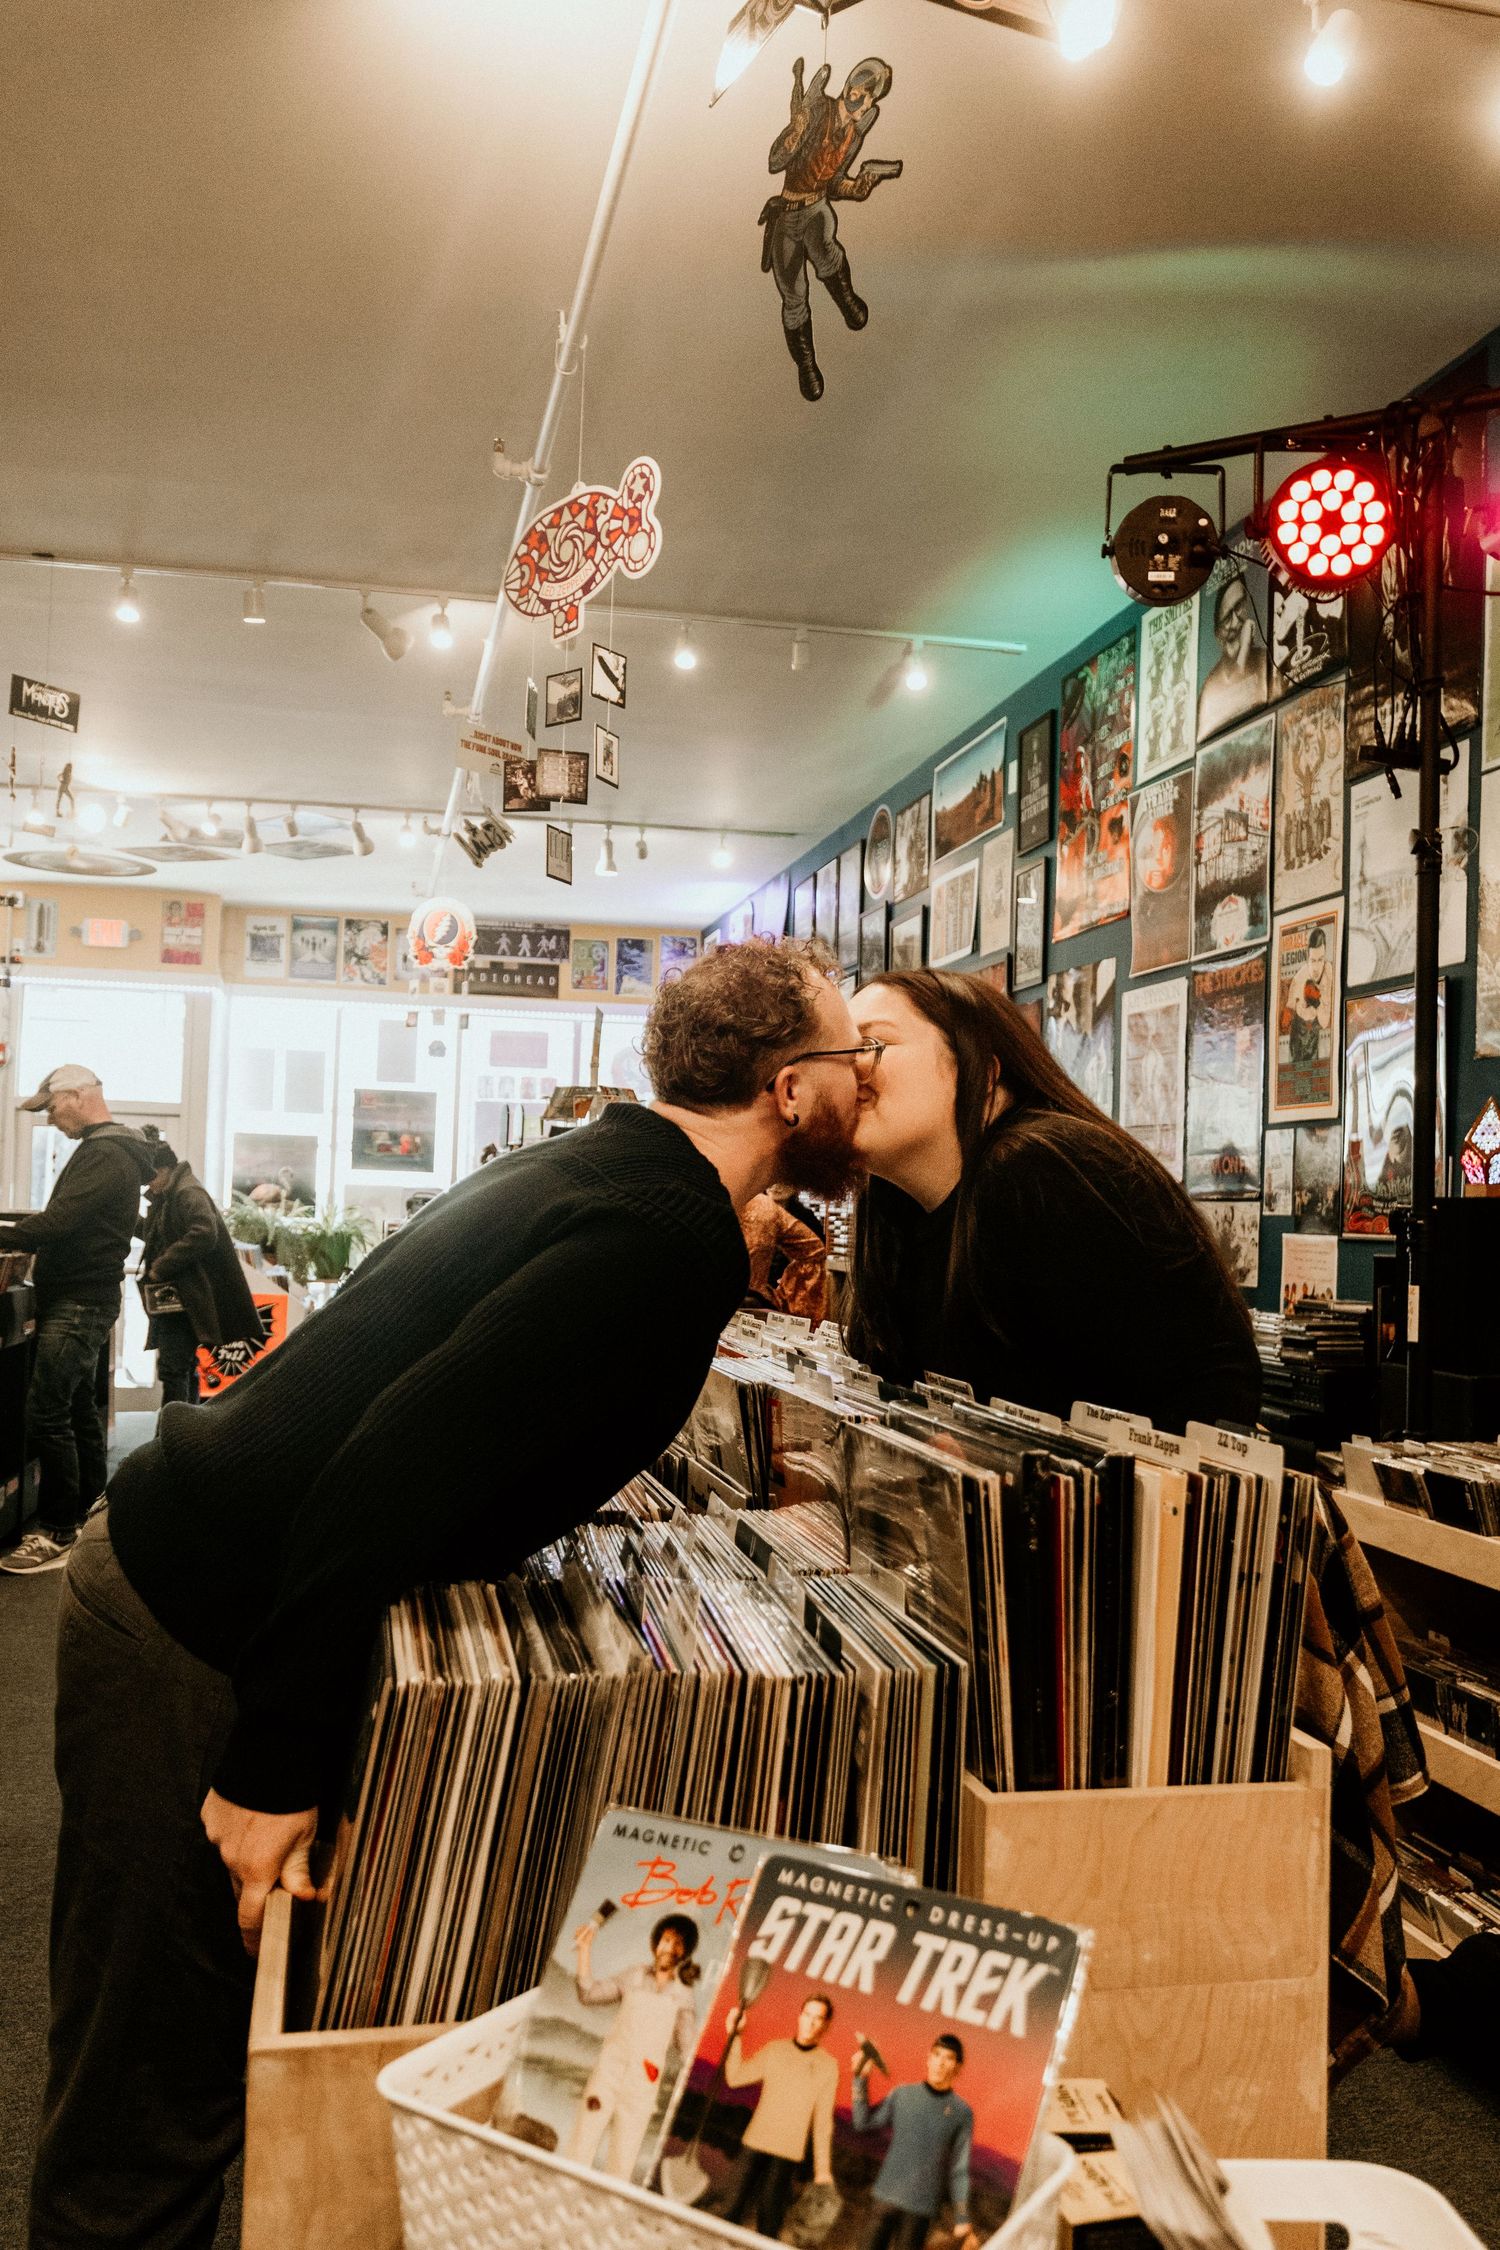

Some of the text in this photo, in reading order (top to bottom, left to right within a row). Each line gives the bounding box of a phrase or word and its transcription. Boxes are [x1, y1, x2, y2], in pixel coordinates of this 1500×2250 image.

[1281, 948, 1307, 967] LEGION
[469, 971, 556, 986] ADIOHEAD
[1086, 1405, 1098, 1418] The
[1128, 1427, 1180, 1457] Frank Zappa
[1217, 1432, 1248, 1457] ZZ Top
[612, 1823, 712, 1856] MAGNETIC
[610, 1855, 719, 1909] Bob
[777, 1867, 895, 1912] MAGNETIC
[928, 1905, 1061, 1953] DRESS-UP
[747, 1894, 897, 1995] STAR
[896, 1930, 1054, 2039] TREK
